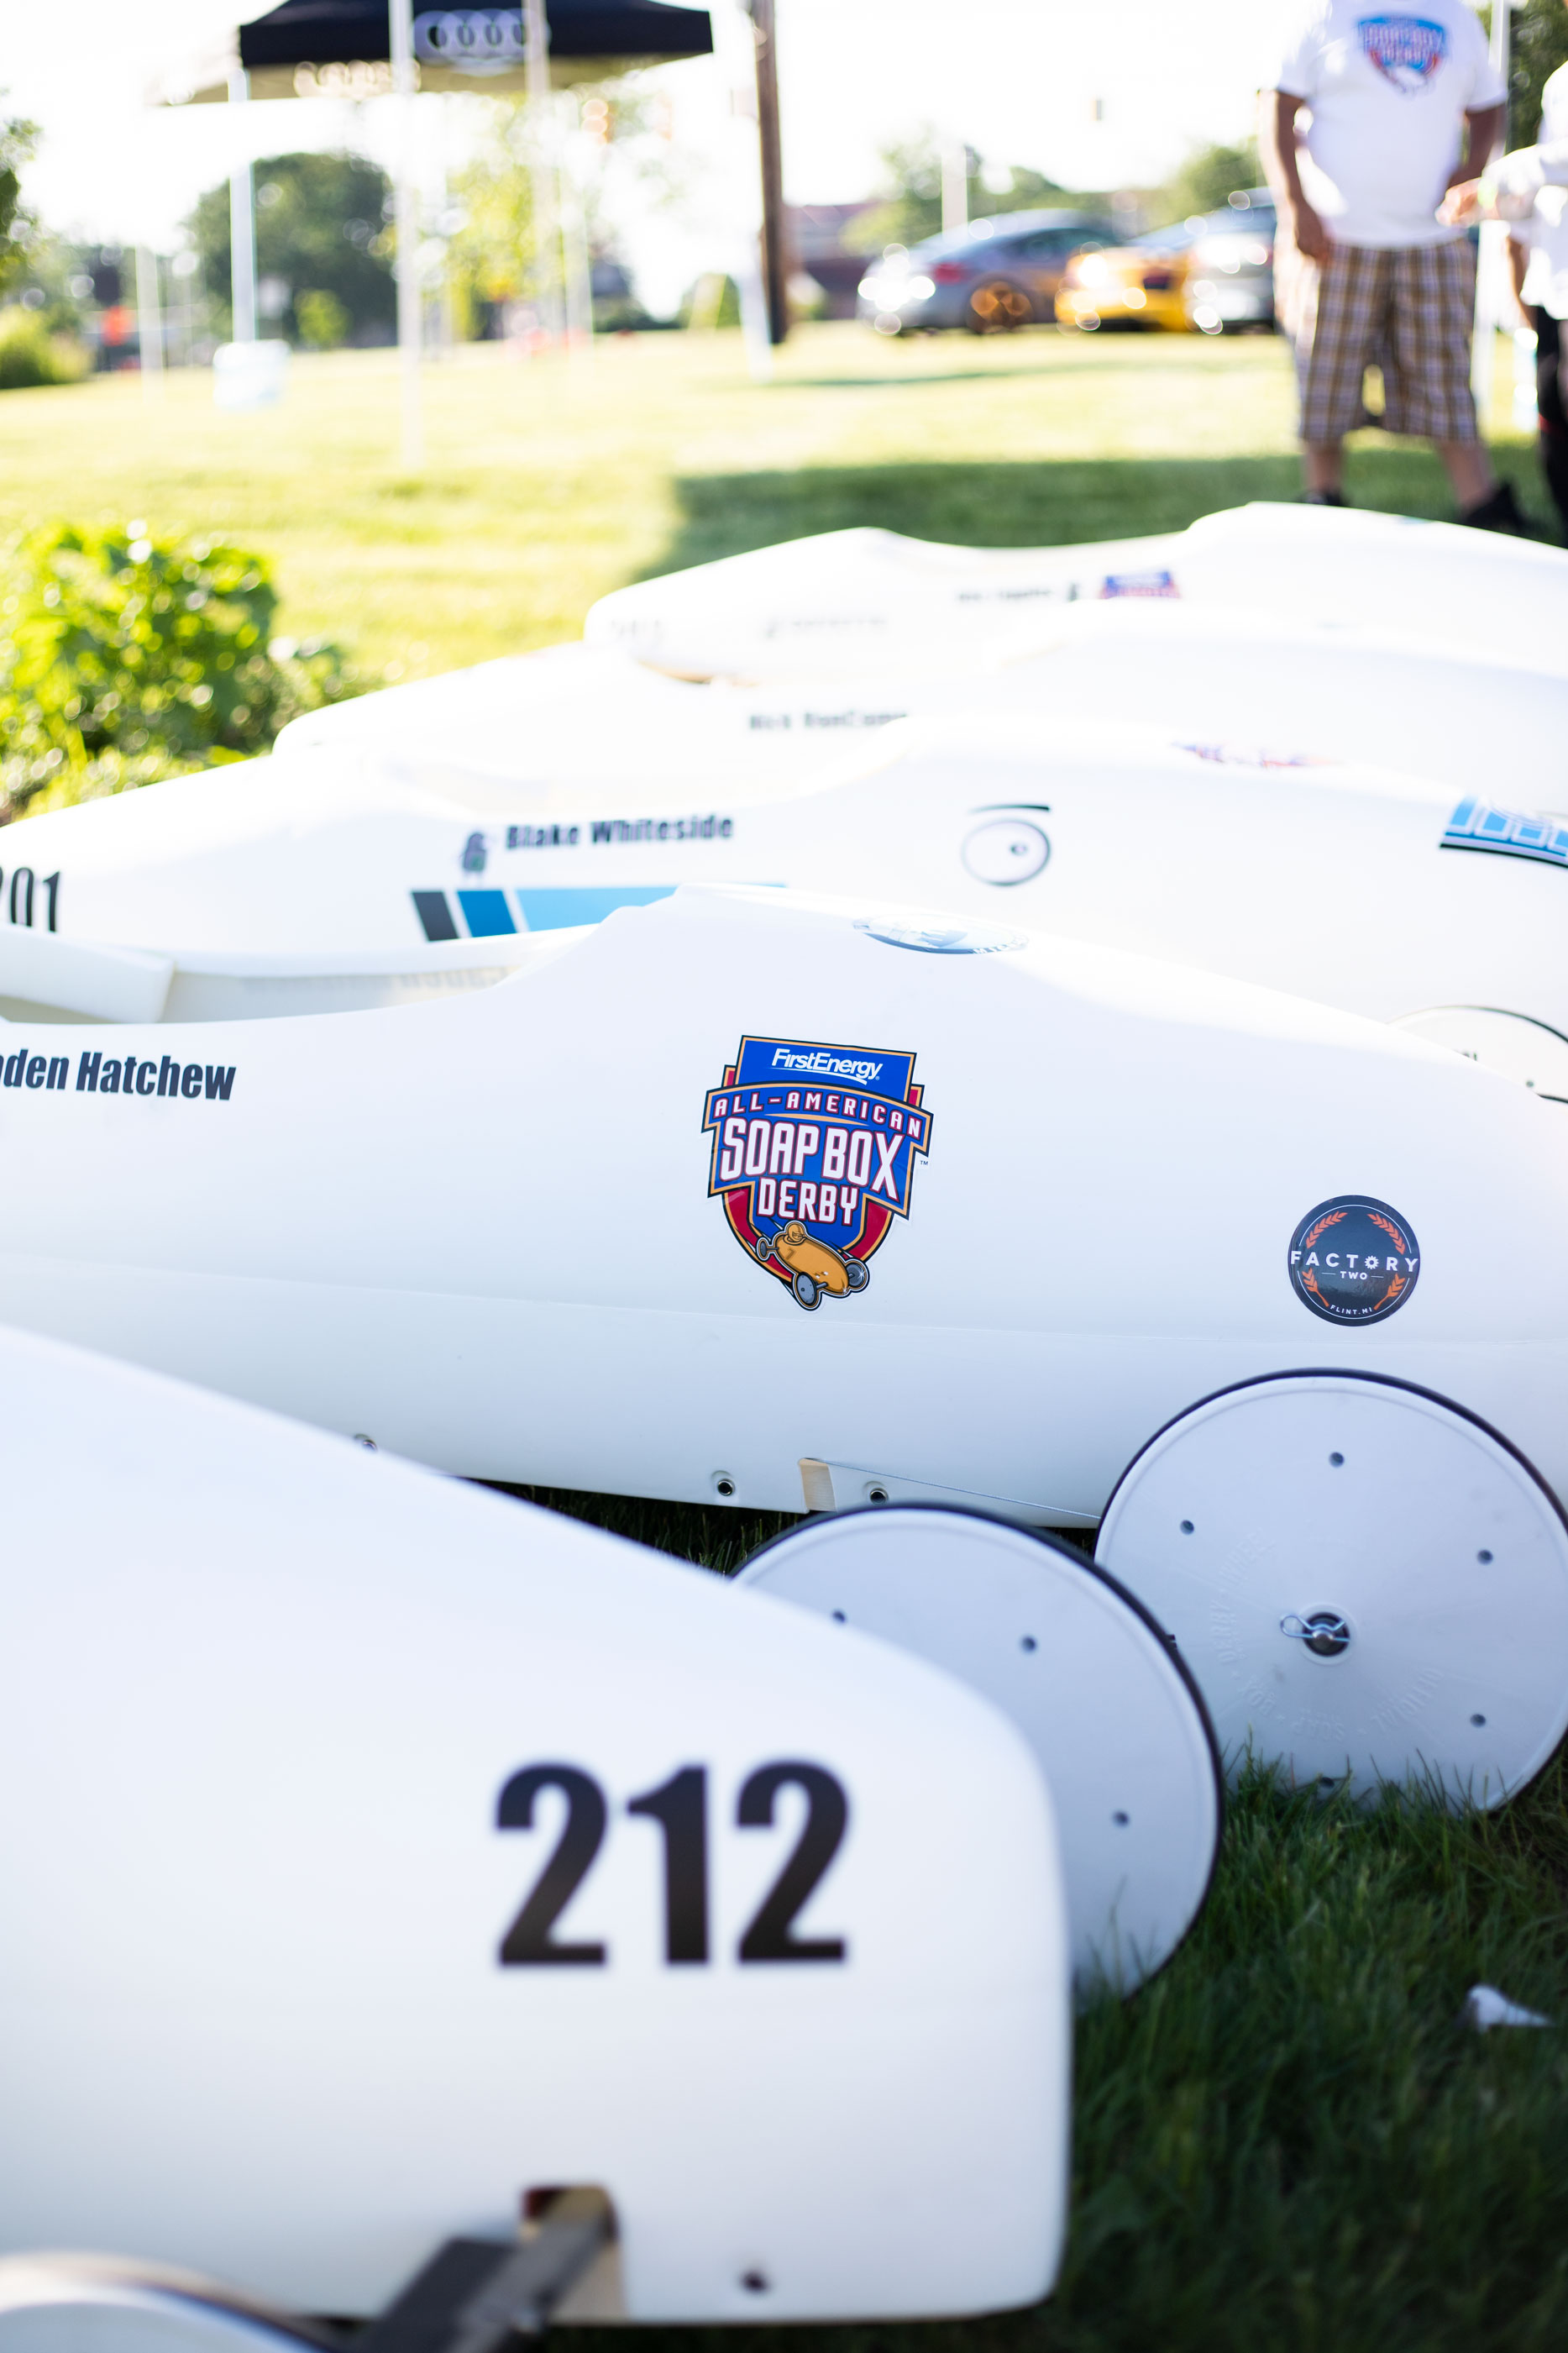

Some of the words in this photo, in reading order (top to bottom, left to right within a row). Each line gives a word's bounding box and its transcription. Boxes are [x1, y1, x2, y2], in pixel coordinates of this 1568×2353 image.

[506, 824, 579, 849] Blake
[590, 813, 732, 843] Whiteside
[0, 866, 60, 932] 01
[0, 1048, 70, 1090] den
[76, 1051, 237, 1101] Hatchew
[772, 1048, 883, 1080] FirstEnergy
[712, 1091, 923, 1140] ALL-AMERICAN
[720, 1116, 821, 1182] SOAP
[821, 1125, 905, 1202] BOX
[757, 1177, 860, 1226] DERBY
[1290, 1250, 1419, 1273] FACTORY
[1340, 1271, 1368, 1280] TWO
[496, 1761, 849, 1967] 212
